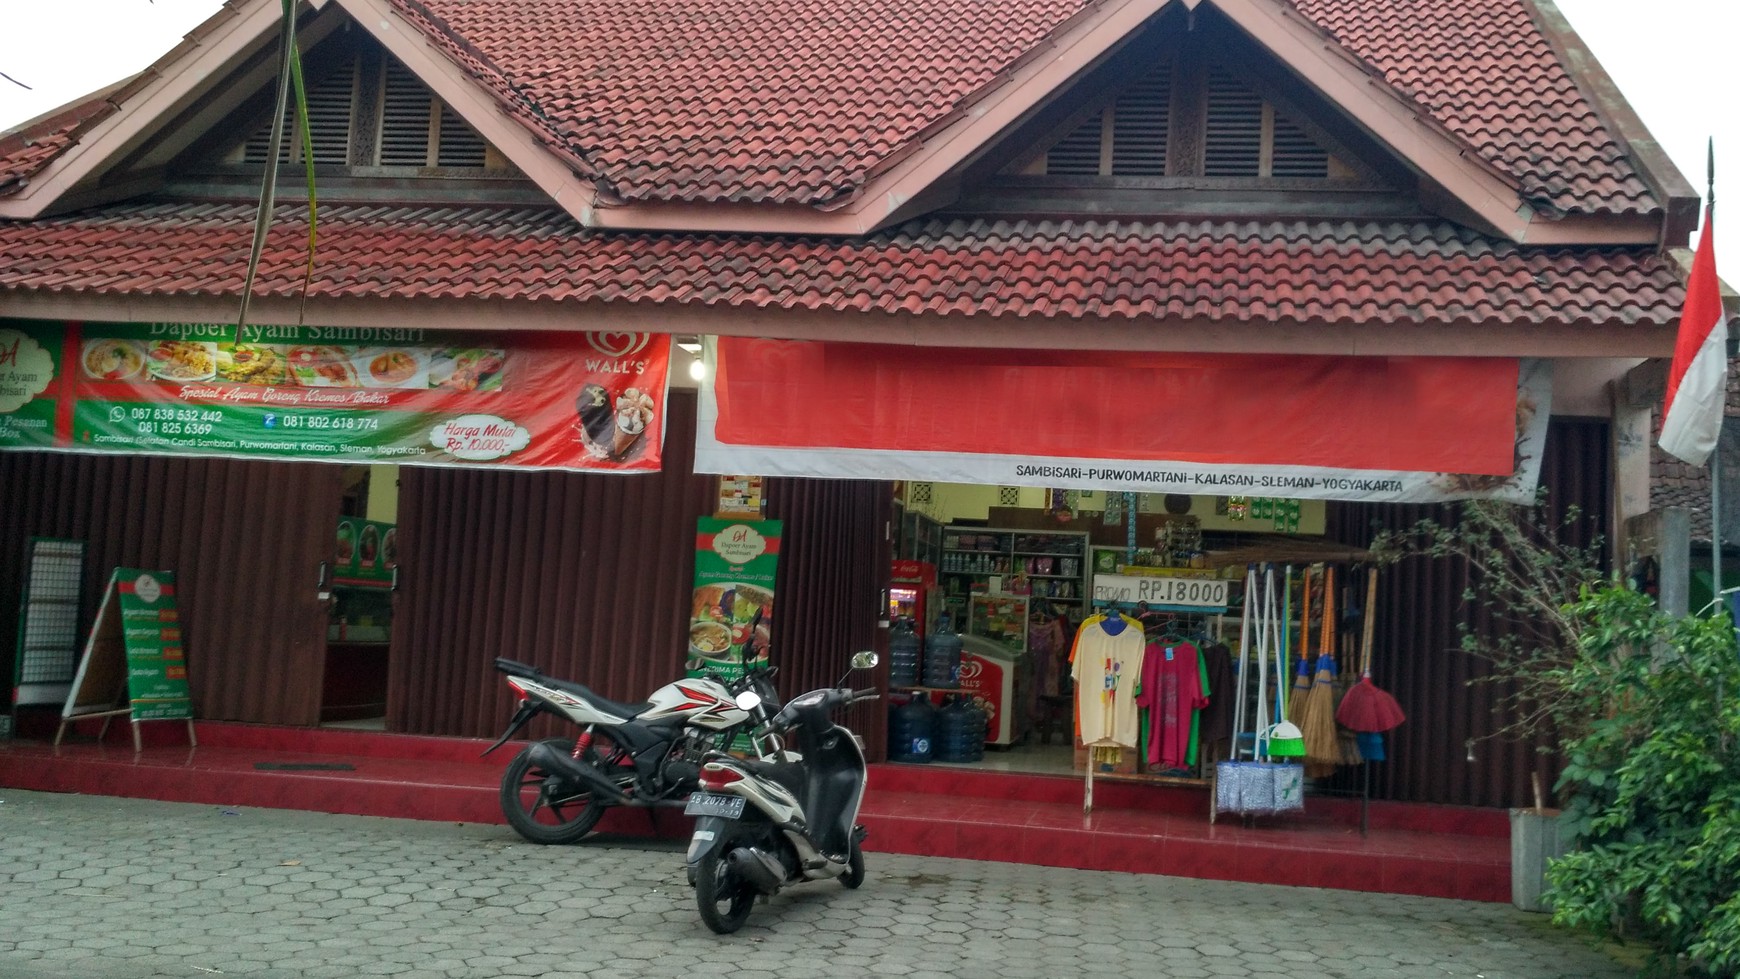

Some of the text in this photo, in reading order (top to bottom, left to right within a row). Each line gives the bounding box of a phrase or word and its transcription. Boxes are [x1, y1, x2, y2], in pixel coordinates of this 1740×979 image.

[150, 322, 425, 342] Dapoer Ayam Sambisari
[585, 359, 645, 375] WALL'S
[8, 371, 38, 383] Ayam
[179, 384, 220, 400] Spesial
[222, 386, 258, 403] Ayam
[262, 387, 301, 404] Goreng
[131, 408, 223, 423] 087 838 532 442
[283, 415, 379, 430] 081 802 618 774
[138, 421, 213, 435] 081 825 6369
[443, 423, 517, 440] Harga Mulai
[171, 437, 196, 447] Candi
[377, 444, 427, 456] Yogyakarta
[446, 438, 464, 453] Rp.
[1095, 585, 1131, 601] PROMO
